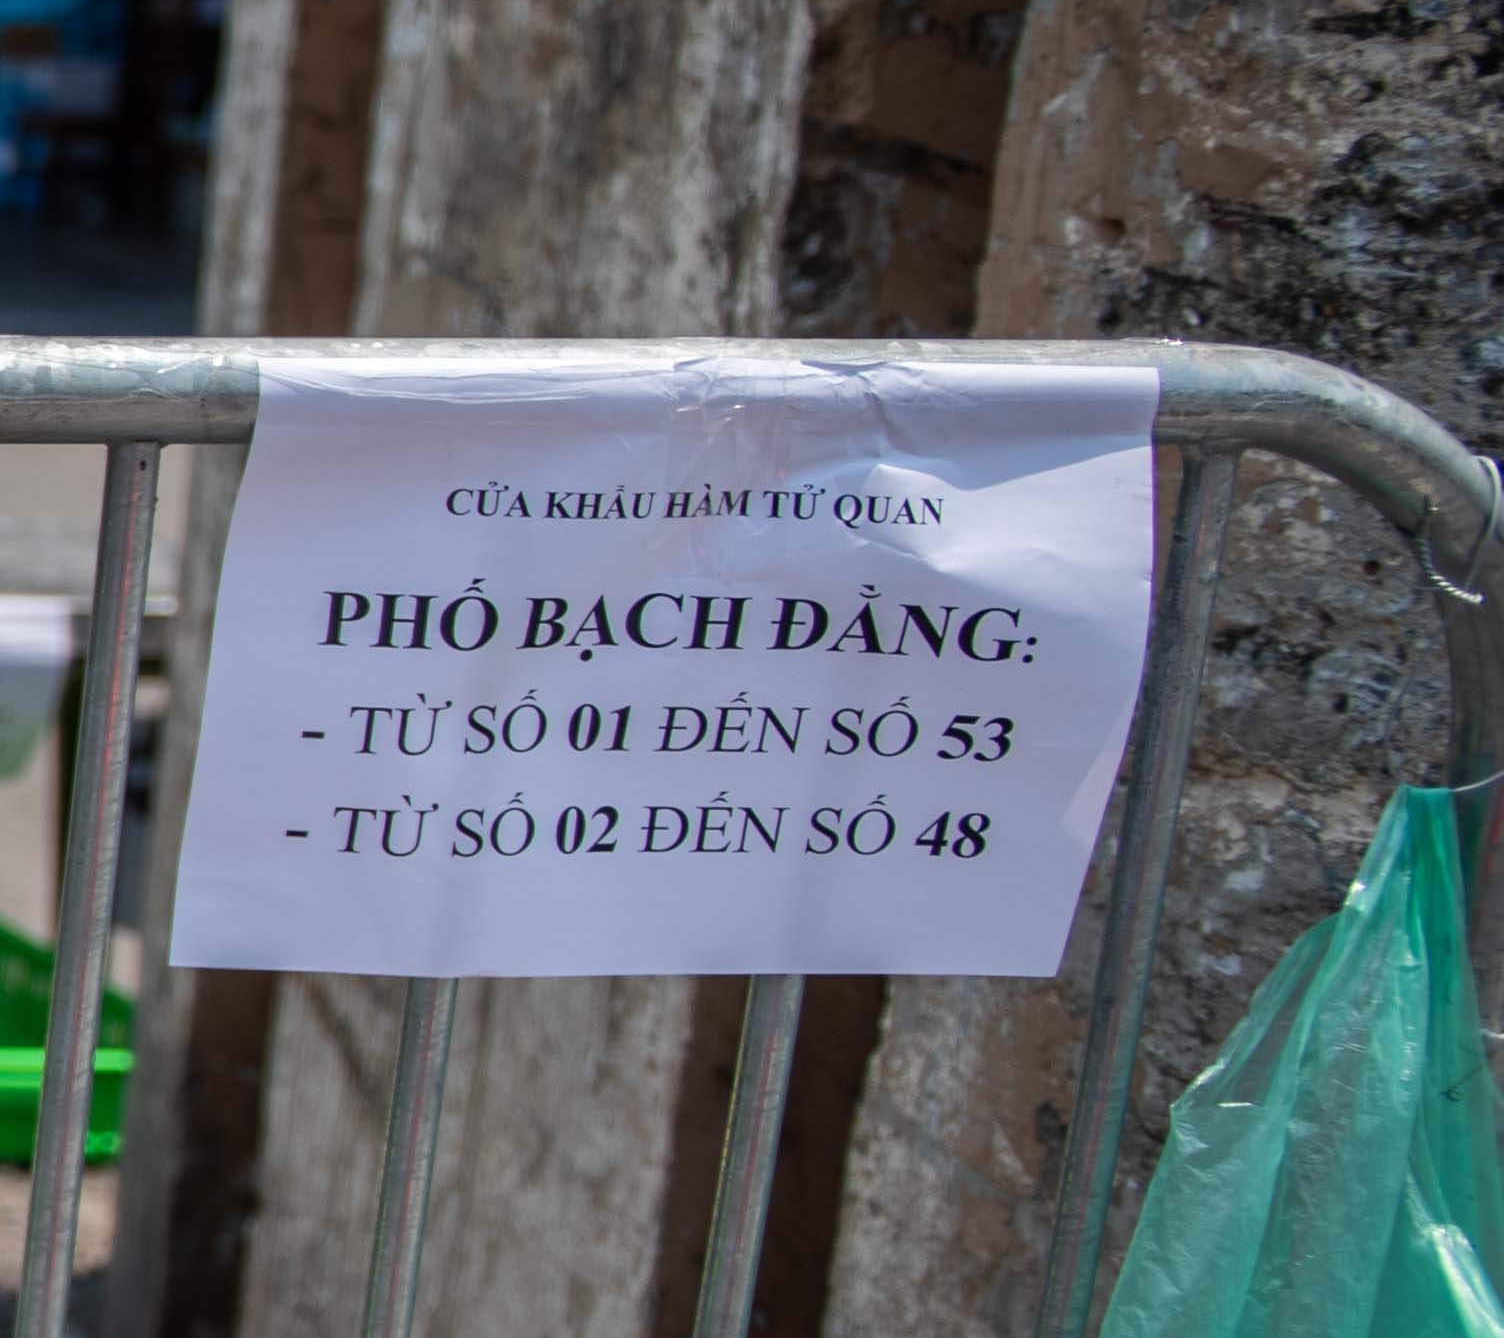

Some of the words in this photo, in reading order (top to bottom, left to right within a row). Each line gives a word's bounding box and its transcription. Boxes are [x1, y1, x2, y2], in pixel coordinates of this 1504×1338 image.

[446, 481, 531, 517] CỬA
[664, 484, 752, 518] HÀM
[763, 484, 826, 520] TỬ
[833, 494, 944, 529] QUAN
[318, 578, 498, 651] PHỐ
[516, 593, 752, 662] BẠCH
[766, 584, 1037, 663] ĐẰNG:
[350, 693, 452, 756] TỪ
[464, 689, 547, 754] SỐ
[568, 704, 631, 751] 01
[654, 692, 810, 753] ĐẾN
[825, 696, 918, 757] SỐ
[937, 715, 1013, 762] 53
[334, 795, 439, 857] TỪ
[452, 792, 535, 857] SỐ
[556, 806, 619, 854] 02
[638, 791, 790, 853] ĐẾN
[805, 794, 895, 855] SỐ
[915, 811, 990, 858] 48
